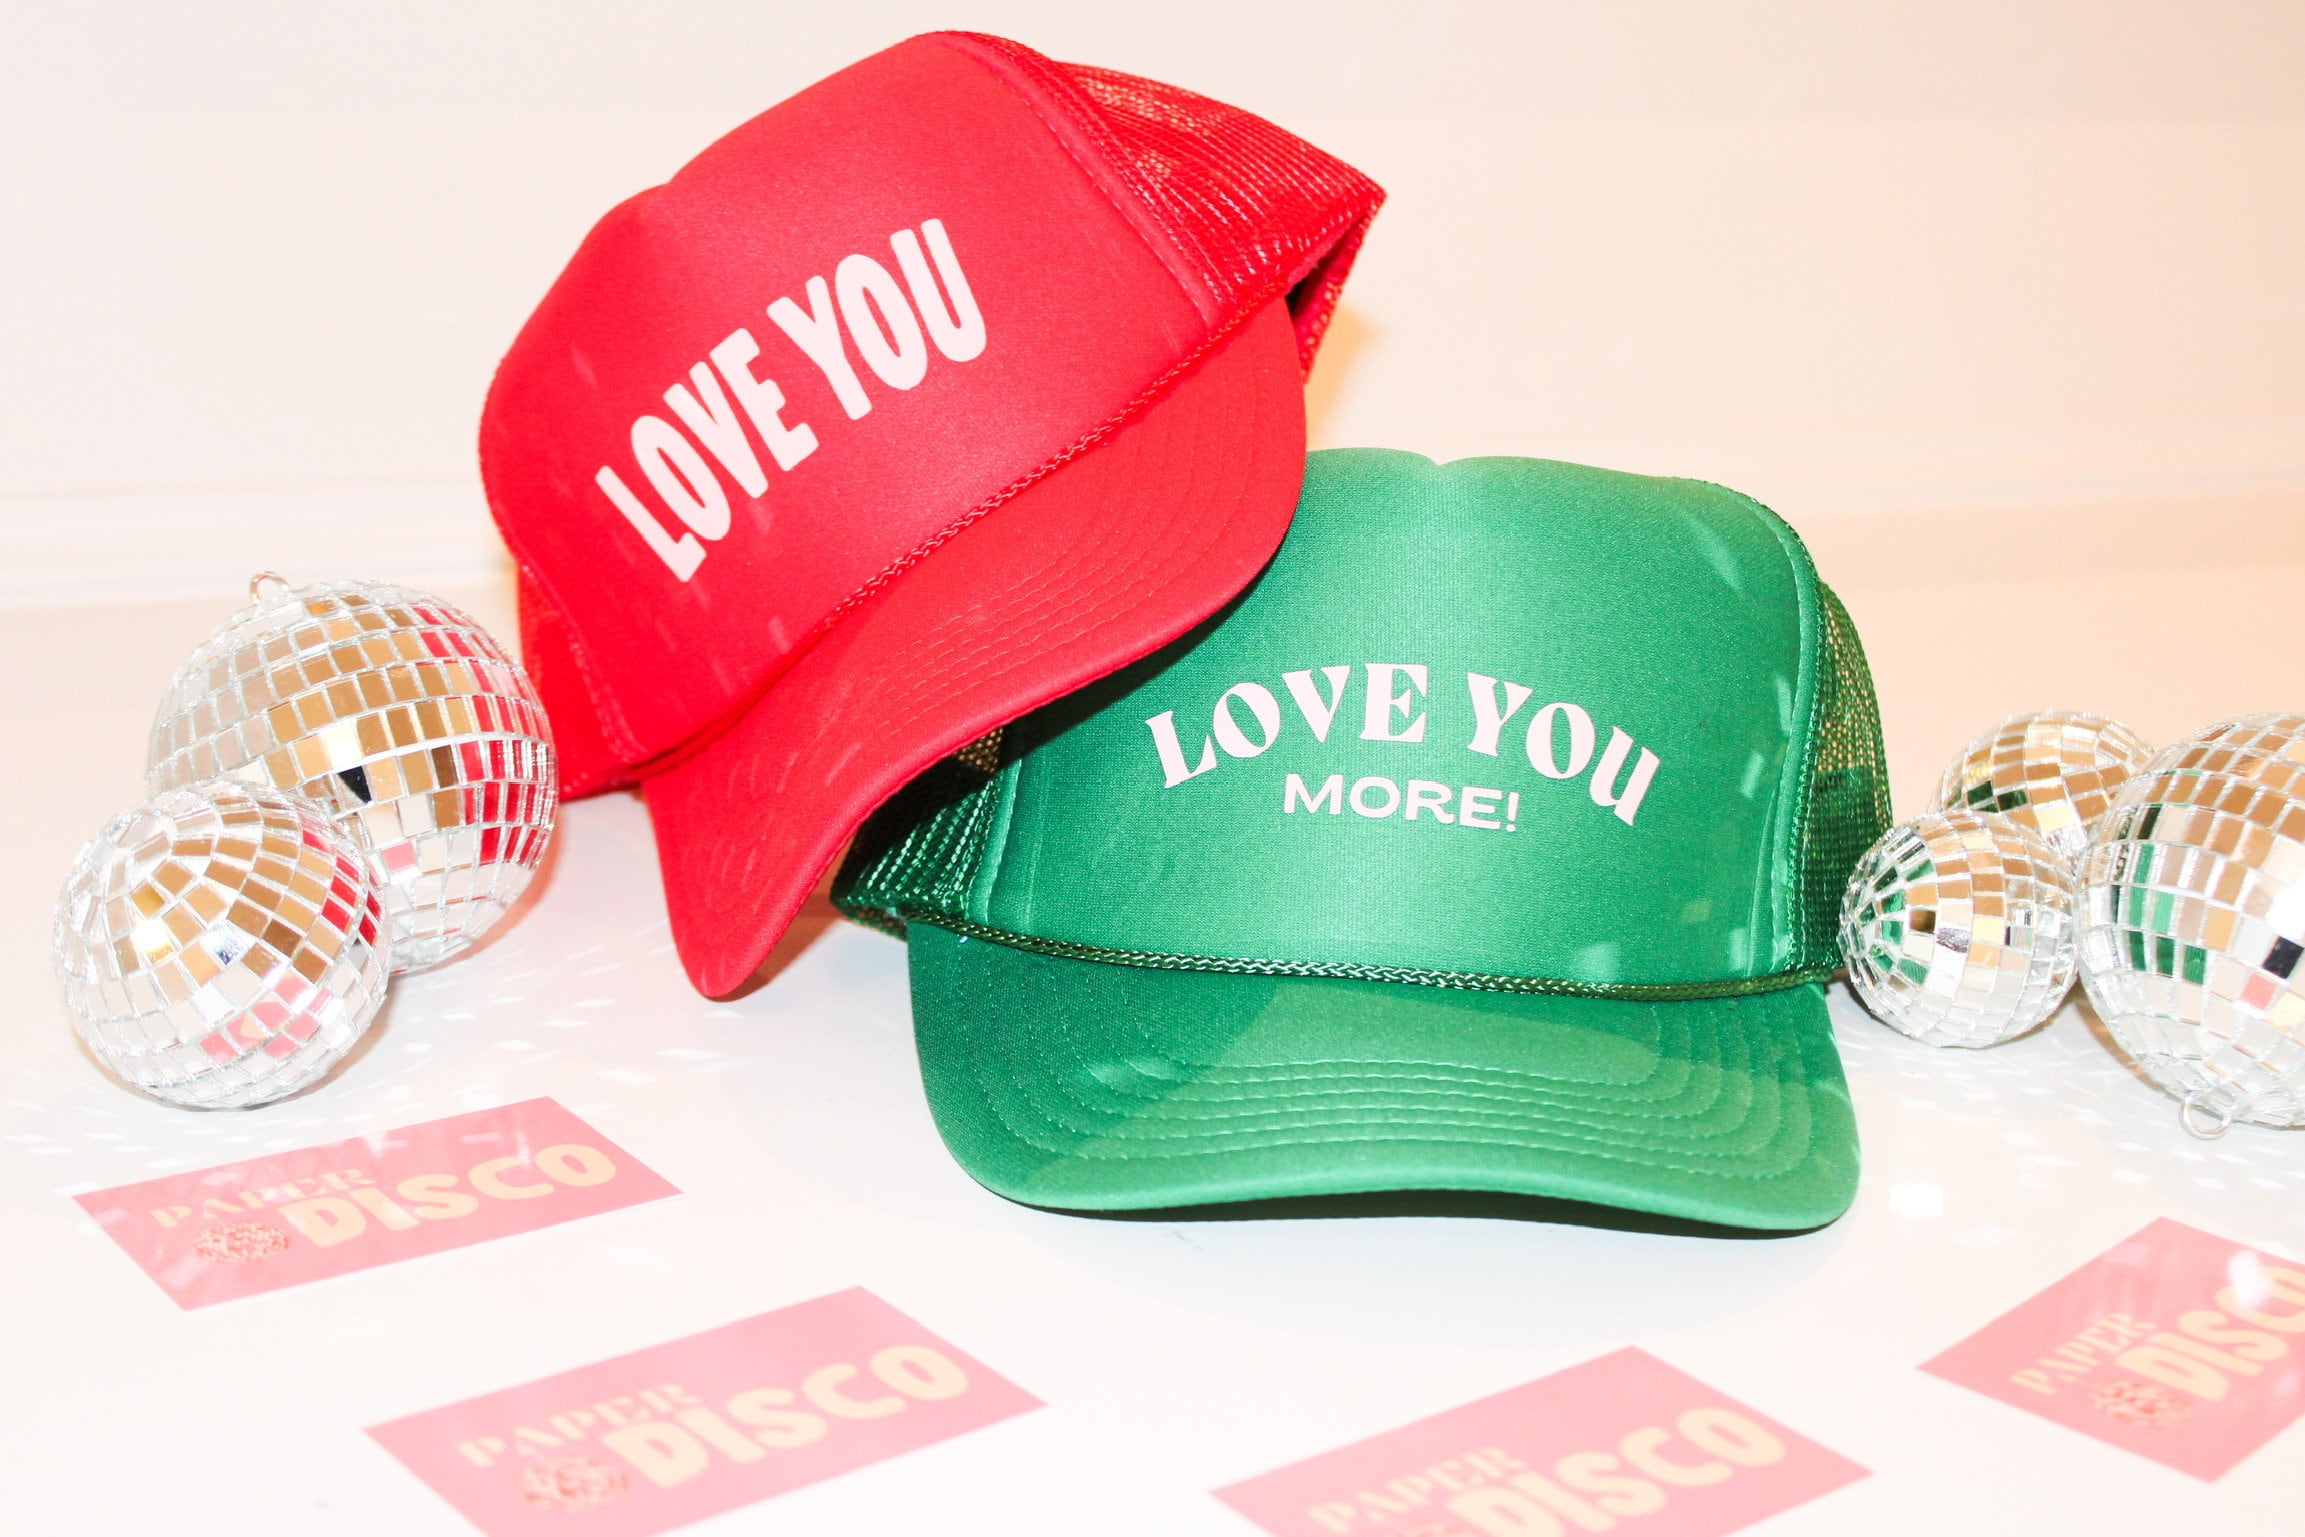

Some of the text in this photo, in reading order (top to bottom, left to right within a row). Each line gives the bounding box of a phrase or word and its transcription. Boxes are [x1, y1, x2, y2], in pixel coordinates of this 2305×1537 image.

[595, 218, 986, 582] LOVE YOU
[1145, 663, 1660, 826] LOVE YOU
[1283, 774, 1520, 832] MORE!
[150, 1168, 376, 1229] PAPER
[277, 1143, 617, 1247] DISCO
[2009, 1312, 2157, 1395] PAPER
[457, 1383, 700, 1468] PAPER
[602, 1345, 970, 1488] DISCO
[1308, 1446, 1530, 1533] PAPER
[1445, 1407, 1786, 1537] DISCO
